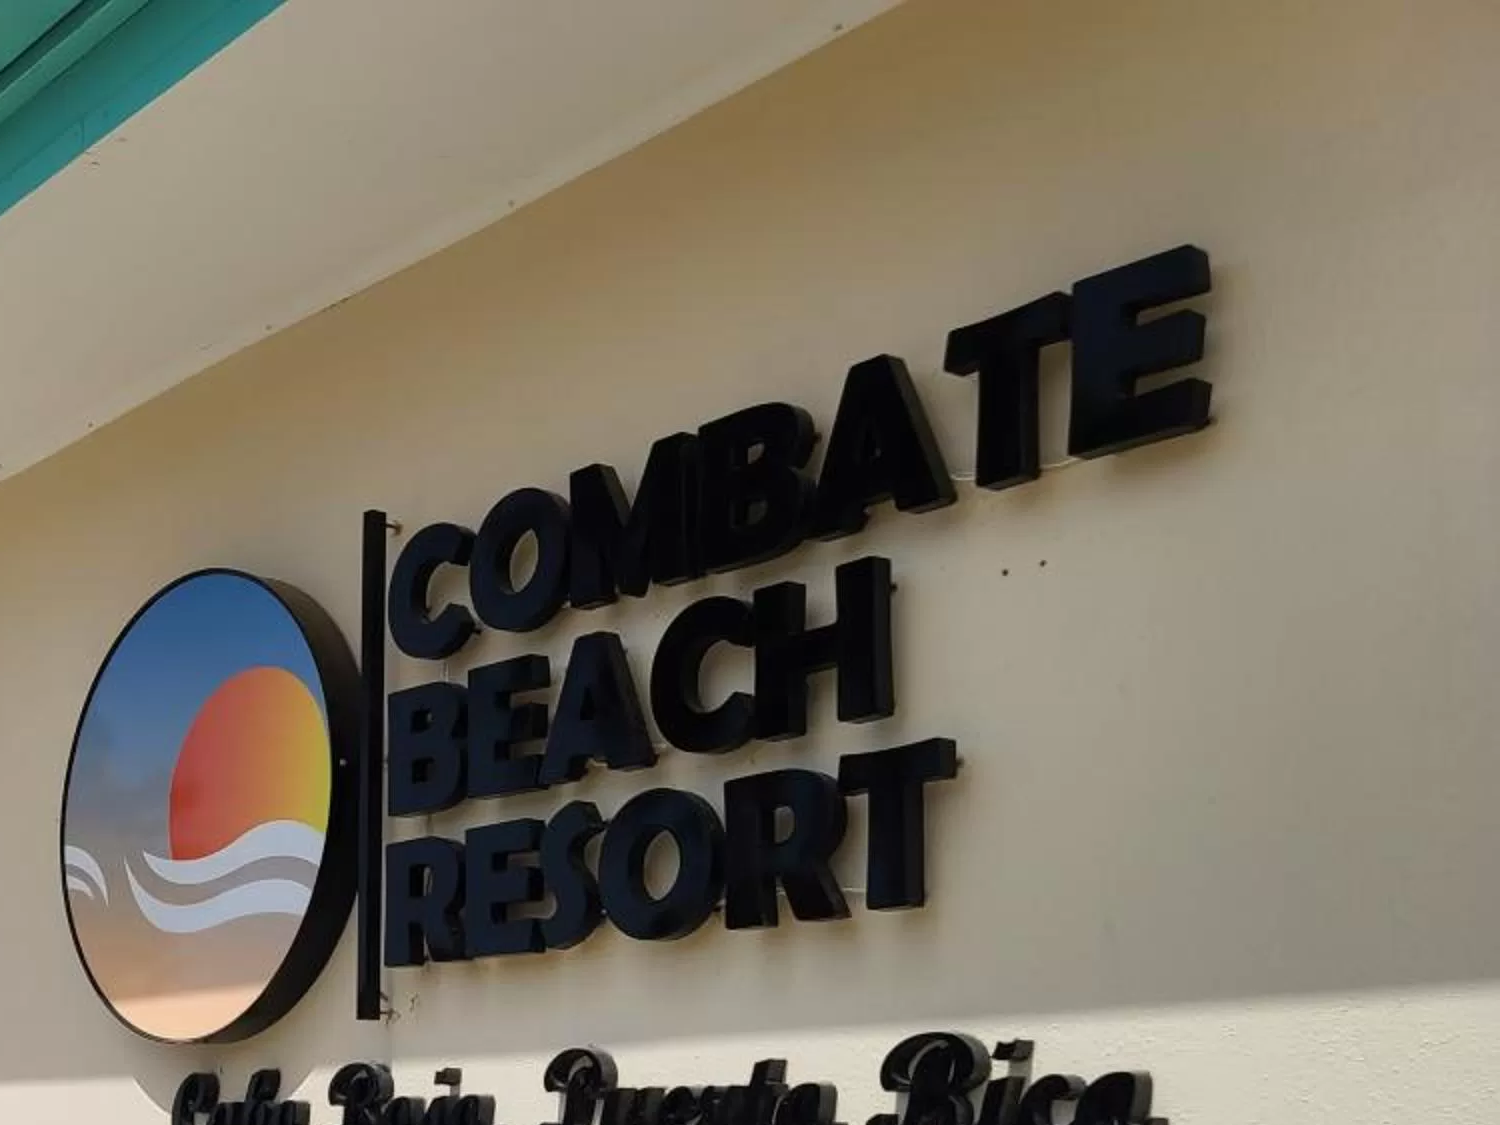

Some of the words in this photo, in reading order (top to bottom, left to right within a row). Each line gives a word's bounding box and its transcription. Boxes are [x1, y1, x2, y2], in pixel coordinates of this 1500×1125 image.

[387, 243, 1216, 660] COMBATE
[387, 554, 896, 818] BEACH
[384, 737, 959, 967] RESORT
